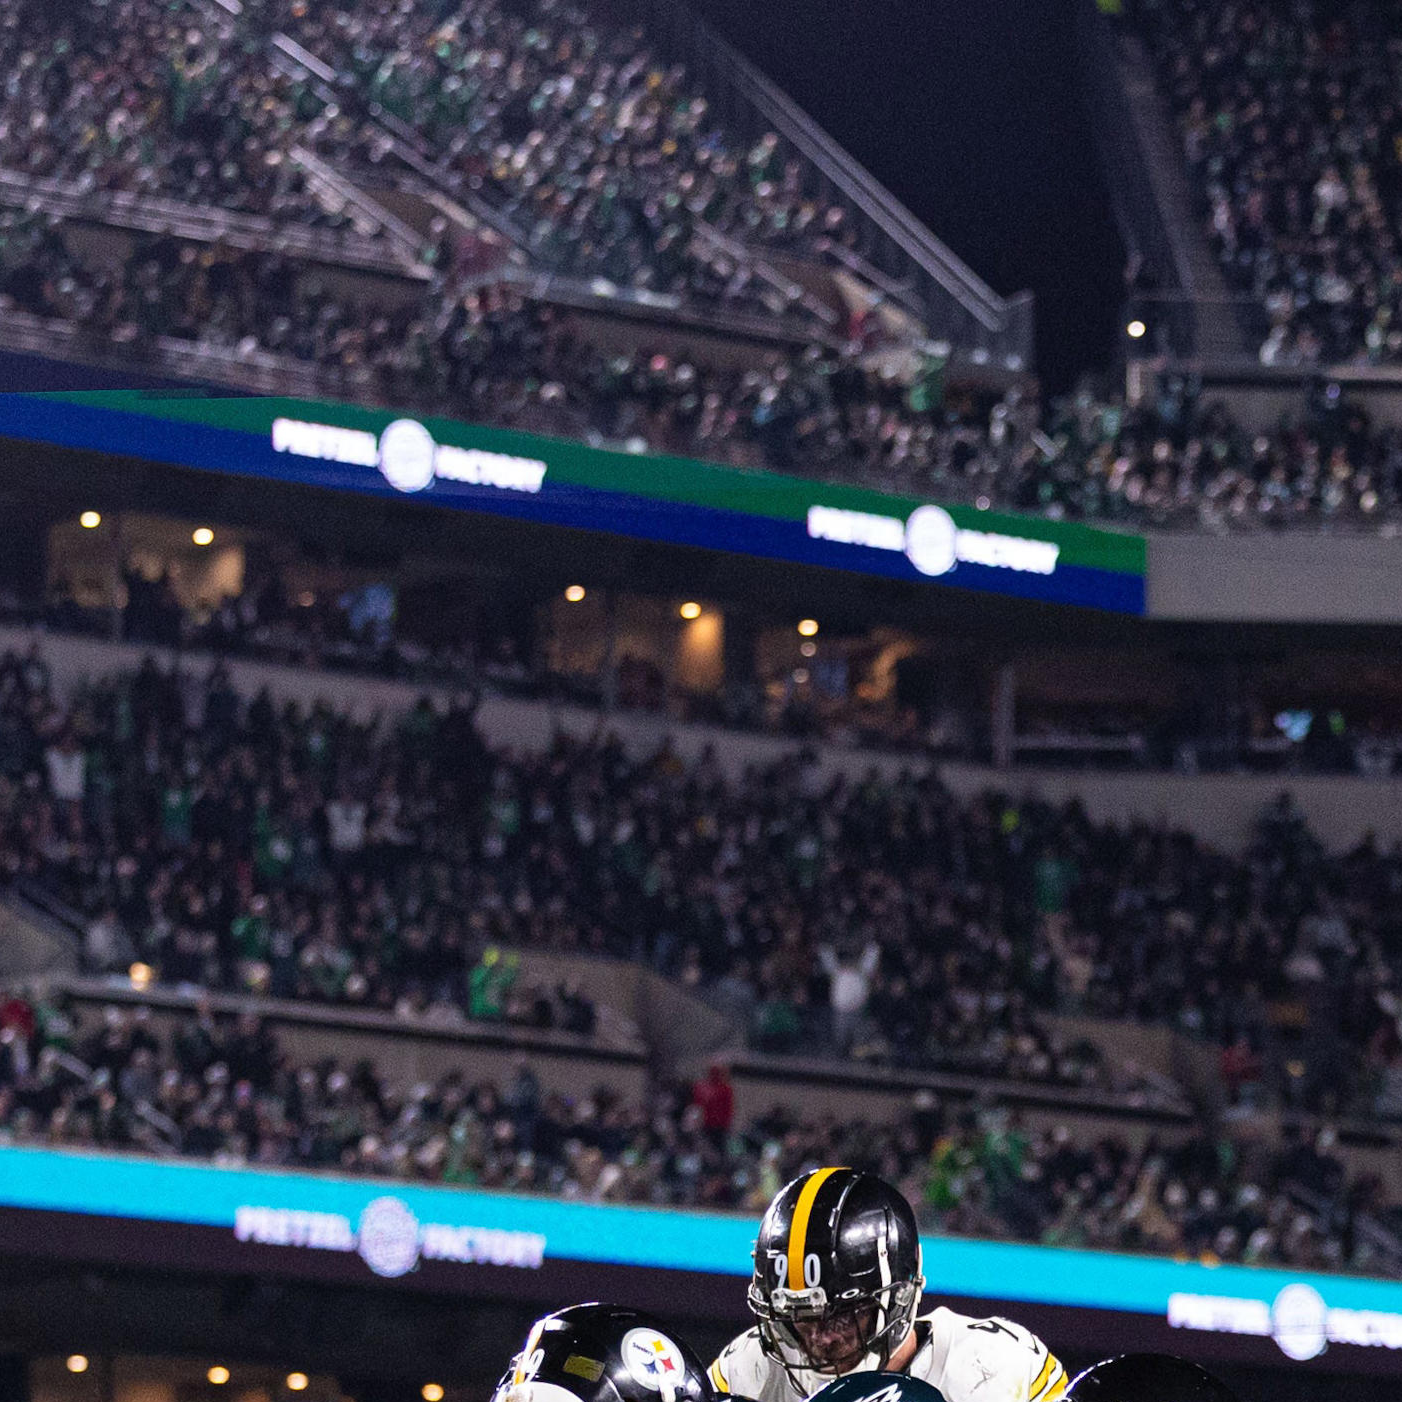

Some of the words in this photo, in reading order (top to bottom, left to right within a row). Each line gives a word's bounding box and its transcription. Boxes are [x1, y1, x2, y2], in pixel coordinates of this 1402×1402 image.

[235, 1205, 356, 1252] PRETZEL
[419, 1223, 547, 1270] FACTORY
[774, 1253, 821, 1289] 90
